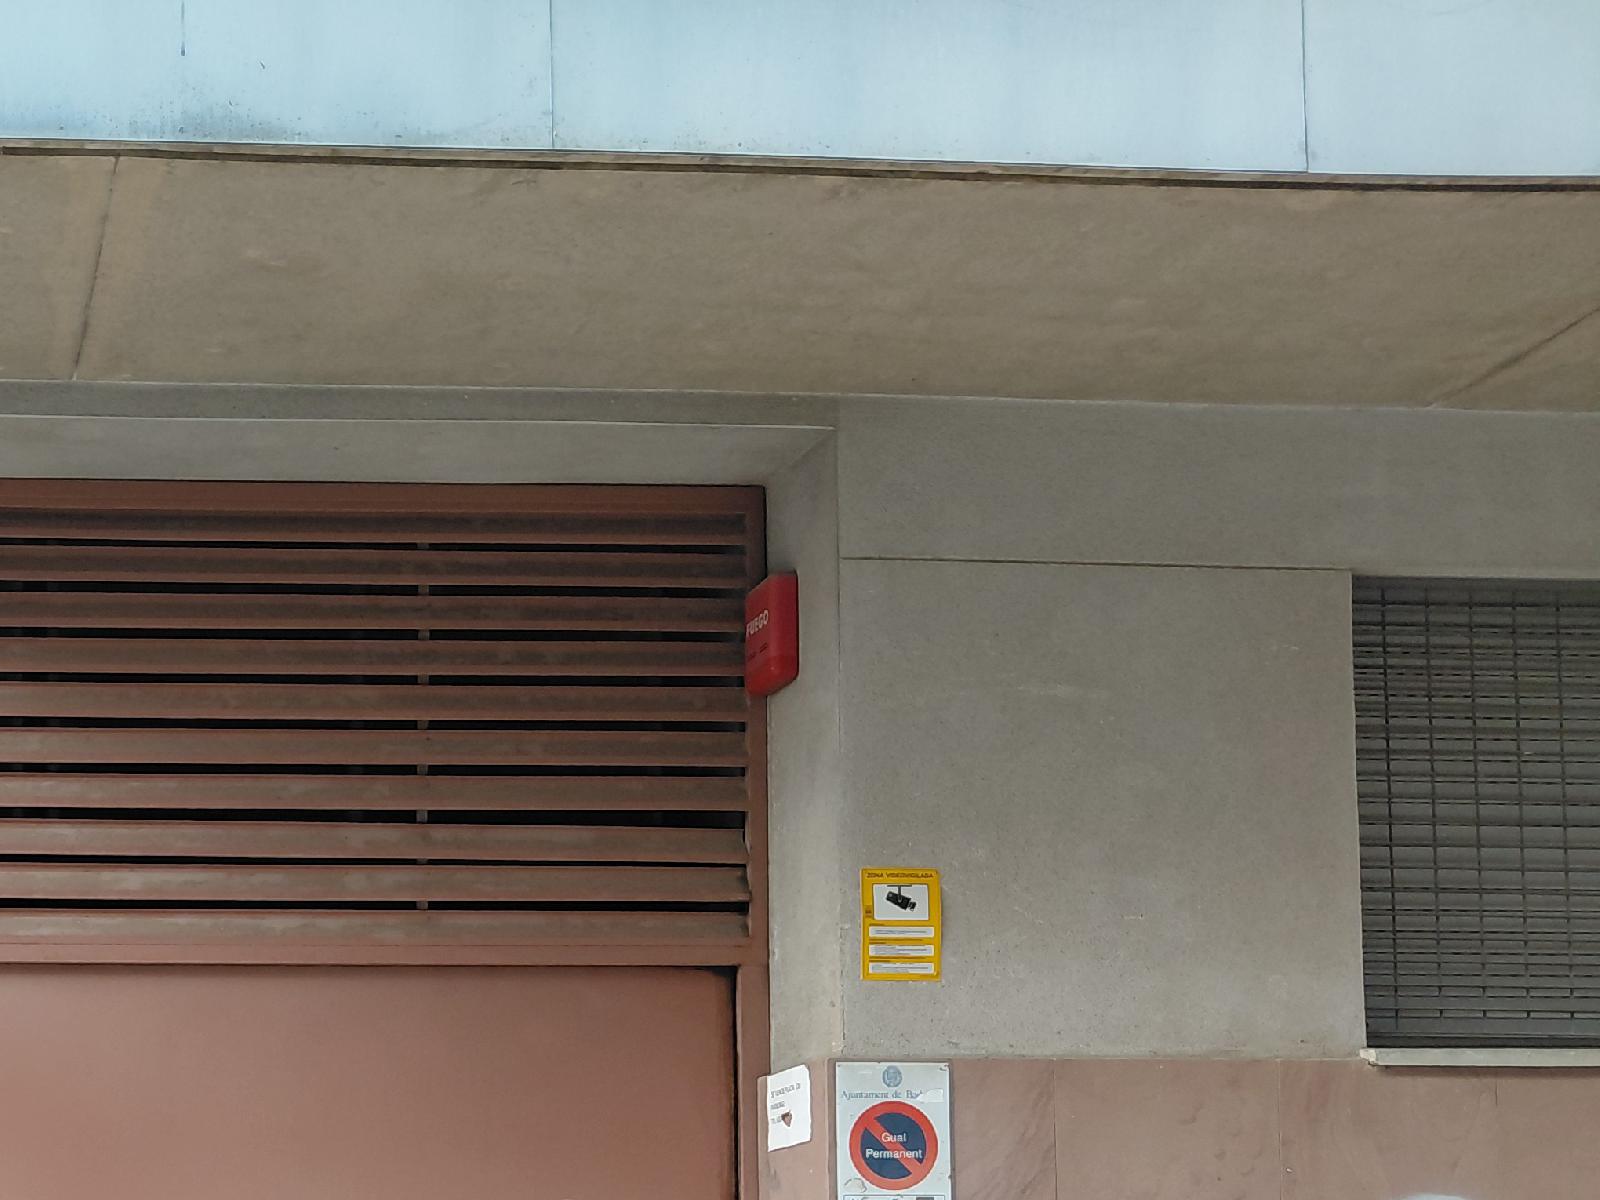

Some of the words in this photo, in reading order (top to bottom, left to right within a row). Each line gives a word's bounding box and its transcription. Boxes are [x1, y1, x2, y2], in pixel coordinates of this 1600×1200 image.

[746, 609, 769, 638] FUEGO
[841, 1089, 889, 1101] Ajuntament
[891, 1089, 902, 1099] de
[881, 1132, 907, 1143] Gual
[865, 1149, 923, 1160] Permanent
